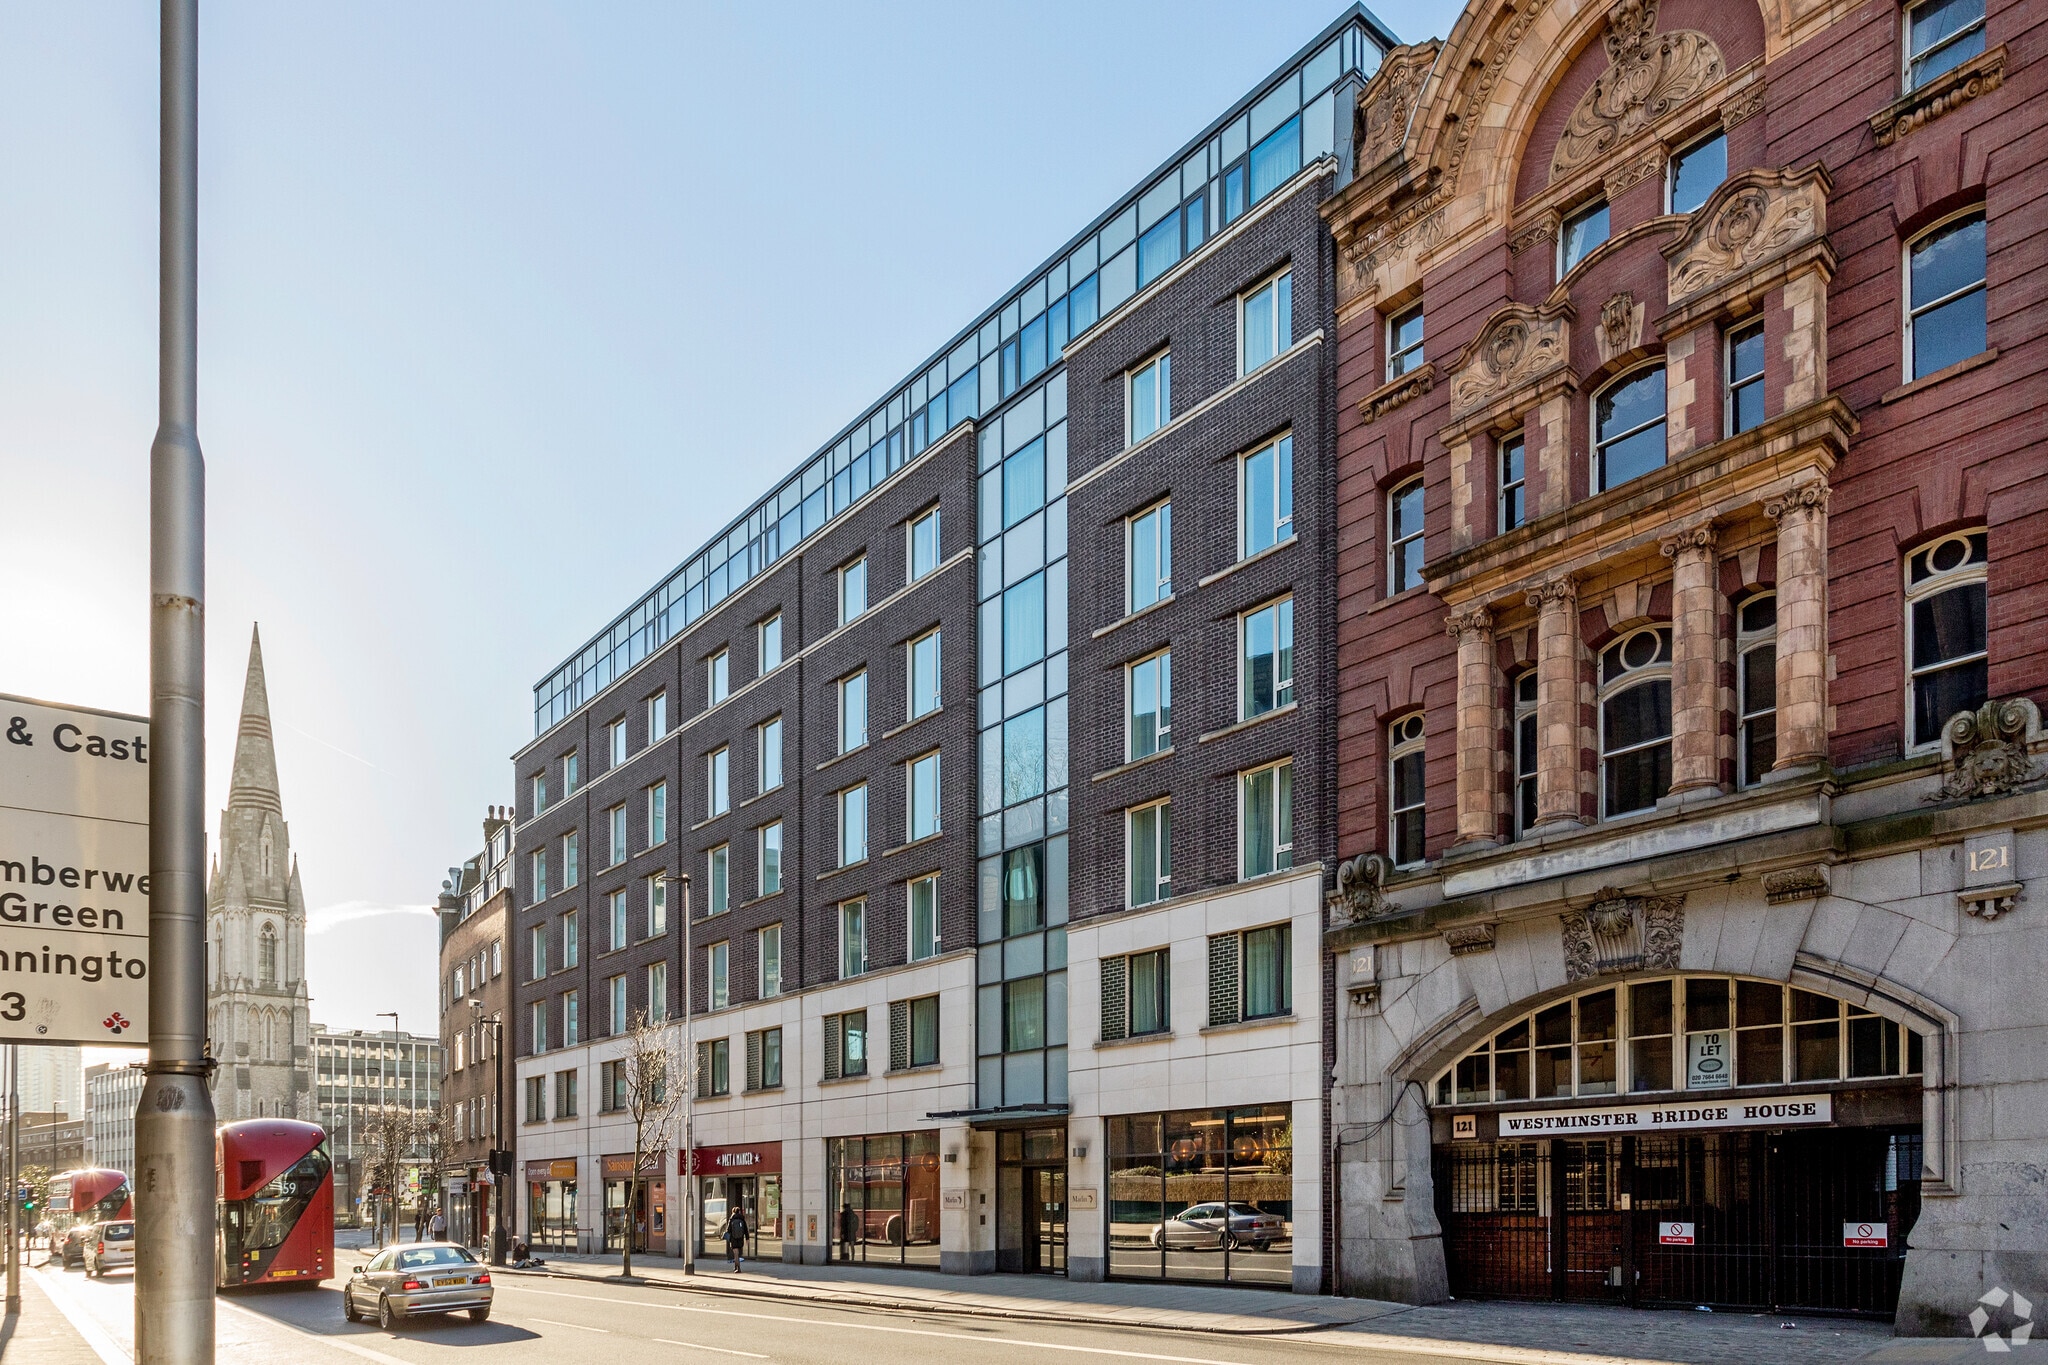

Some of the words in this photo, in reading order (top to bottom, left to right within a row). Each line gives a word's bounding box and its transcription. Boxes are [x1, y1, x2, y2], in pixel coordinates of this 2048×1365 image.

[6, 716, 33, 746] &
[53, 723, 147, 763] Cast
[1970, 846, 2009, 872] 121
[0, 892, 124, 930] Green
[1352, 957, 1372, 974] 121
[1704, 1033, 1720, 1045] TO
[1700, 1045, 1722, 1056] LET
[1456, 1121, 1473, 1132] 121
[1508, 1112, 1638, 1130] WESTMINSTER
[1651, 1107, 1728, 1123] BRIDGE
[1744, 1102, 1816, 1119] HOUSE
